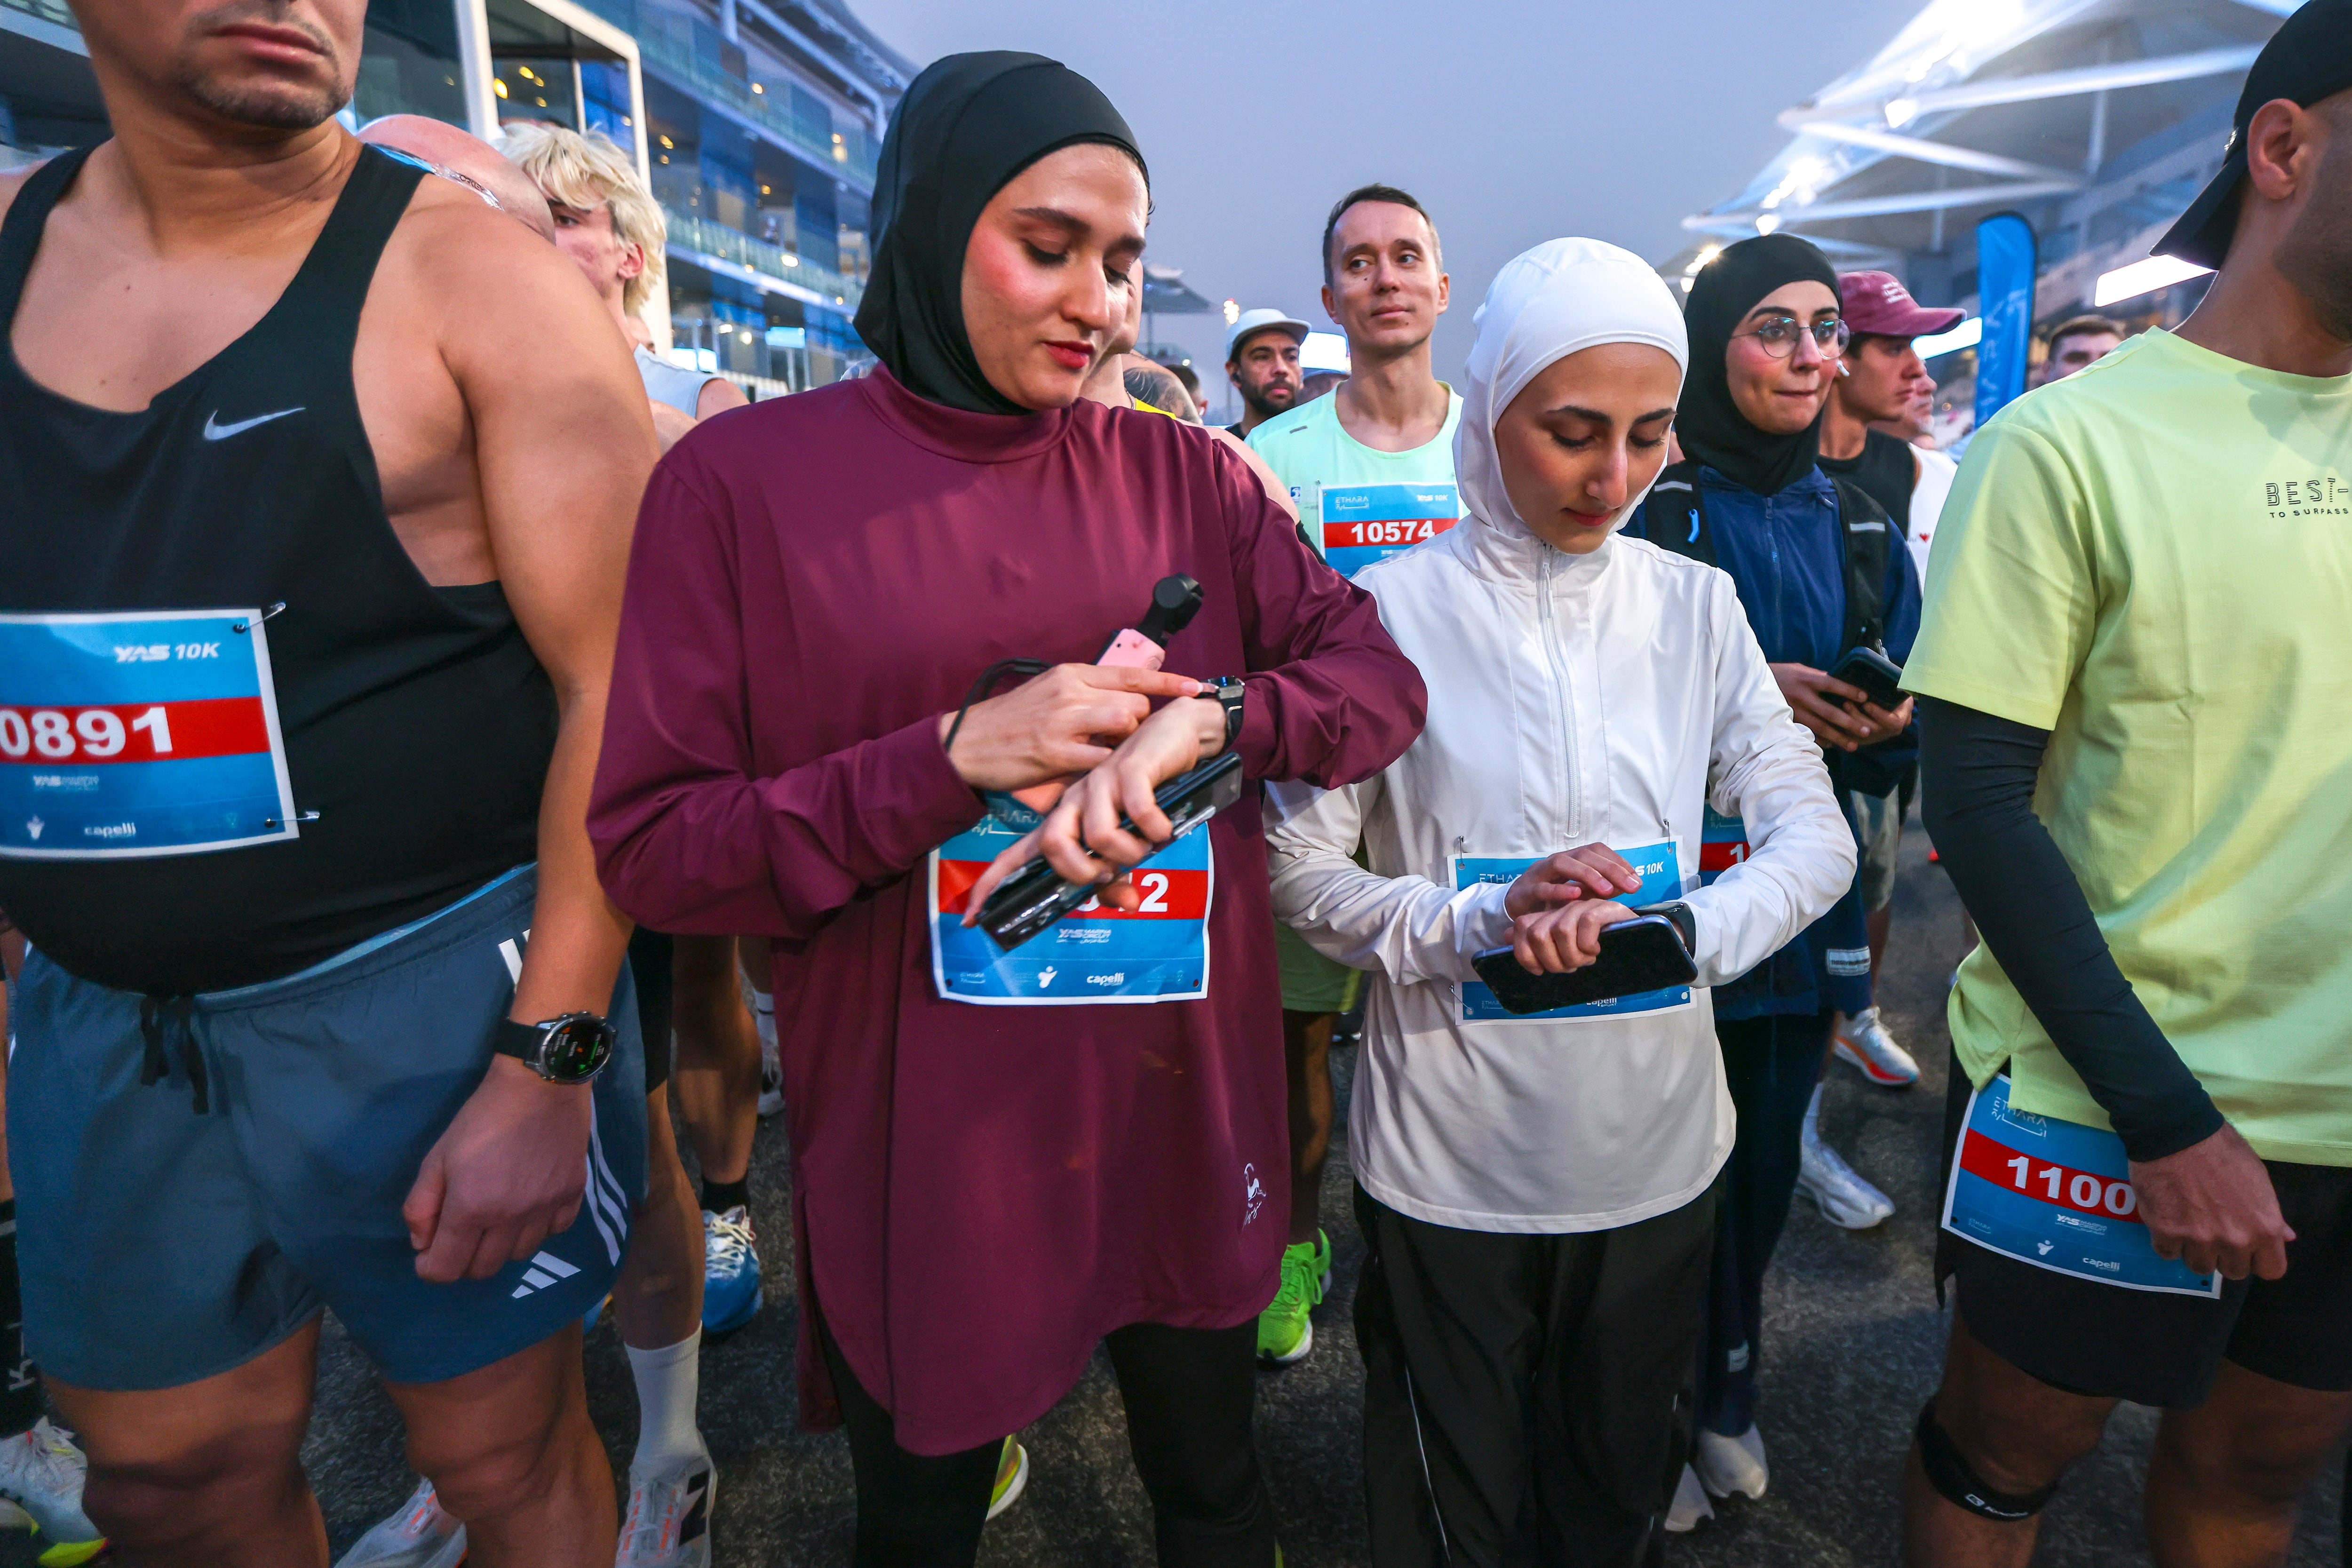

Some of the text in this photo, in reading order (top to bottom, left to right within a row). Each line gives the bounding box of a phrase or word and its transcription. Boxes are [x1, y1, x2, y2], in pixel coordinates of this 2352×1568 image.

[2294, 508, 2349, 517] SURPASS
[1351, 520, 1435, 543] 10574
[114, 643, 221, 662] YAS 10K
[85, 822, 136, 838] capelli
[1646, 861, 1664, 875] 10K
[1087, 972, 1125, 986] capelli
[2008, 1155, 2137, 1215] 1100
[2057, 1214, 2080, 1226] YAS
[2083, 1257, 2120, 1270] capelli
